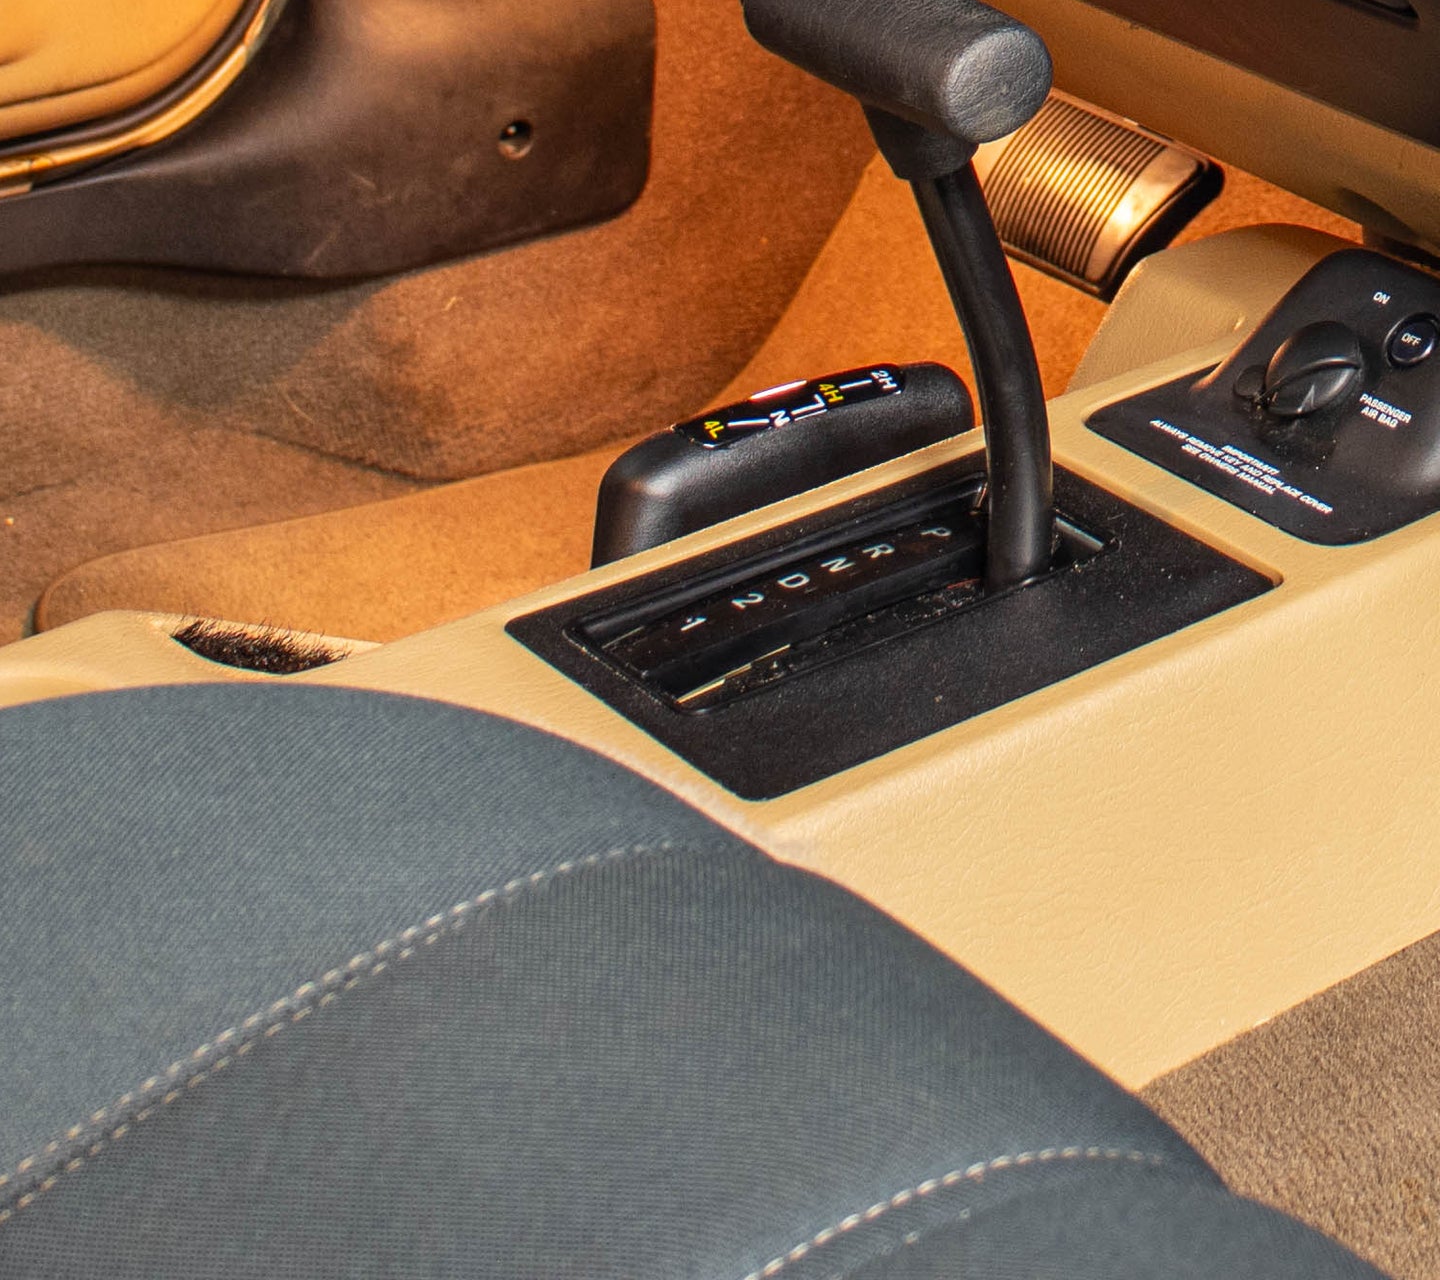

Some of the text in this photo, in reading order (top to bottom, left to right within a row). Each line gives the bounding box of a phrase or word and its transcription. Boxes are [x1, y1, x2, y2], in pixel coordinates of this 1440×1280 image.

[1373, 291, 1391, 305] ON
[1401, 332, 1422, 346] OFF
[870, 369, 898, 390] 2H
[818, 383, 845, 404] 4H
[1359, 393, 1412, 424] PASSENGER
[1361, 406, 1399, 429] AIR BAG
[704, 420, 725, 439] 4L
[1149, 418, 1334, 515] ALWAYS REMOVE KEY AND REPLACE COVER
[1180, 443, 1203, 457] SEE
[1236, 471, 1277, 496] MANUAL
[920, 526, 952, 538] P
[862, 543, 896, 559] R
[820, 556, 856, 573] N
[777, 572, 810, 589] D
[731, 592, 765, 610] 2
[680, 616, 707, 632] 1
